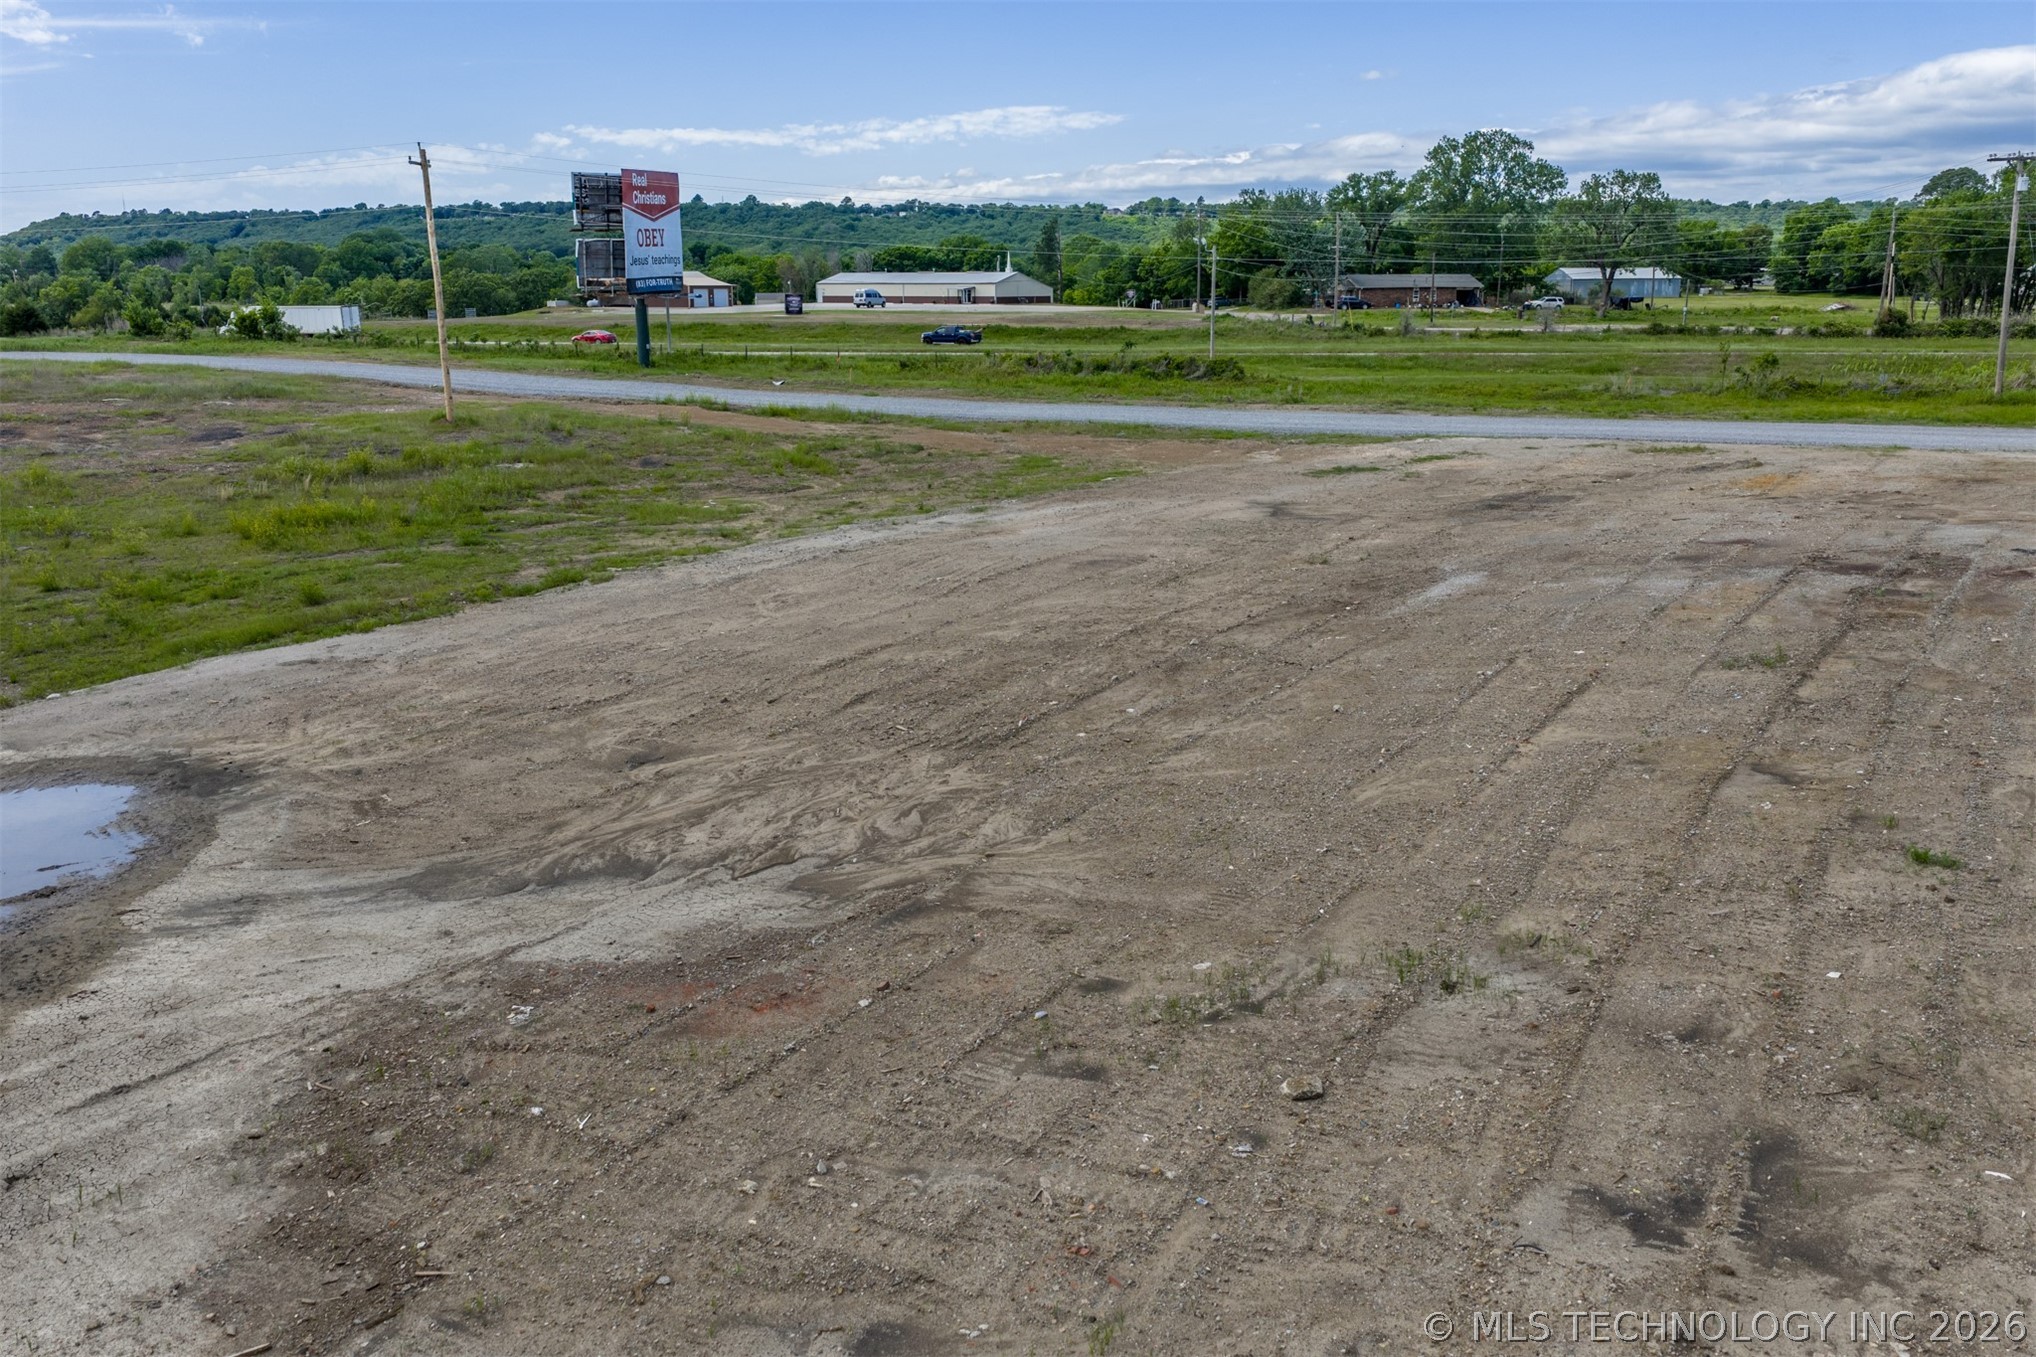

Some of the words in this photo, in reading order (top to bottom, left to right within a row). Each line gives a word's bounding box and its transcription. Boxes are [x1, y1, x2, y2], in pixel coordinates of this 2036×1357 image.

[632, 173, 647, 187] Real
[632, 191, 667, 205] Christians
[636, 228, 665, 248] OBEY
[652, 254, 681, 268] teachings
